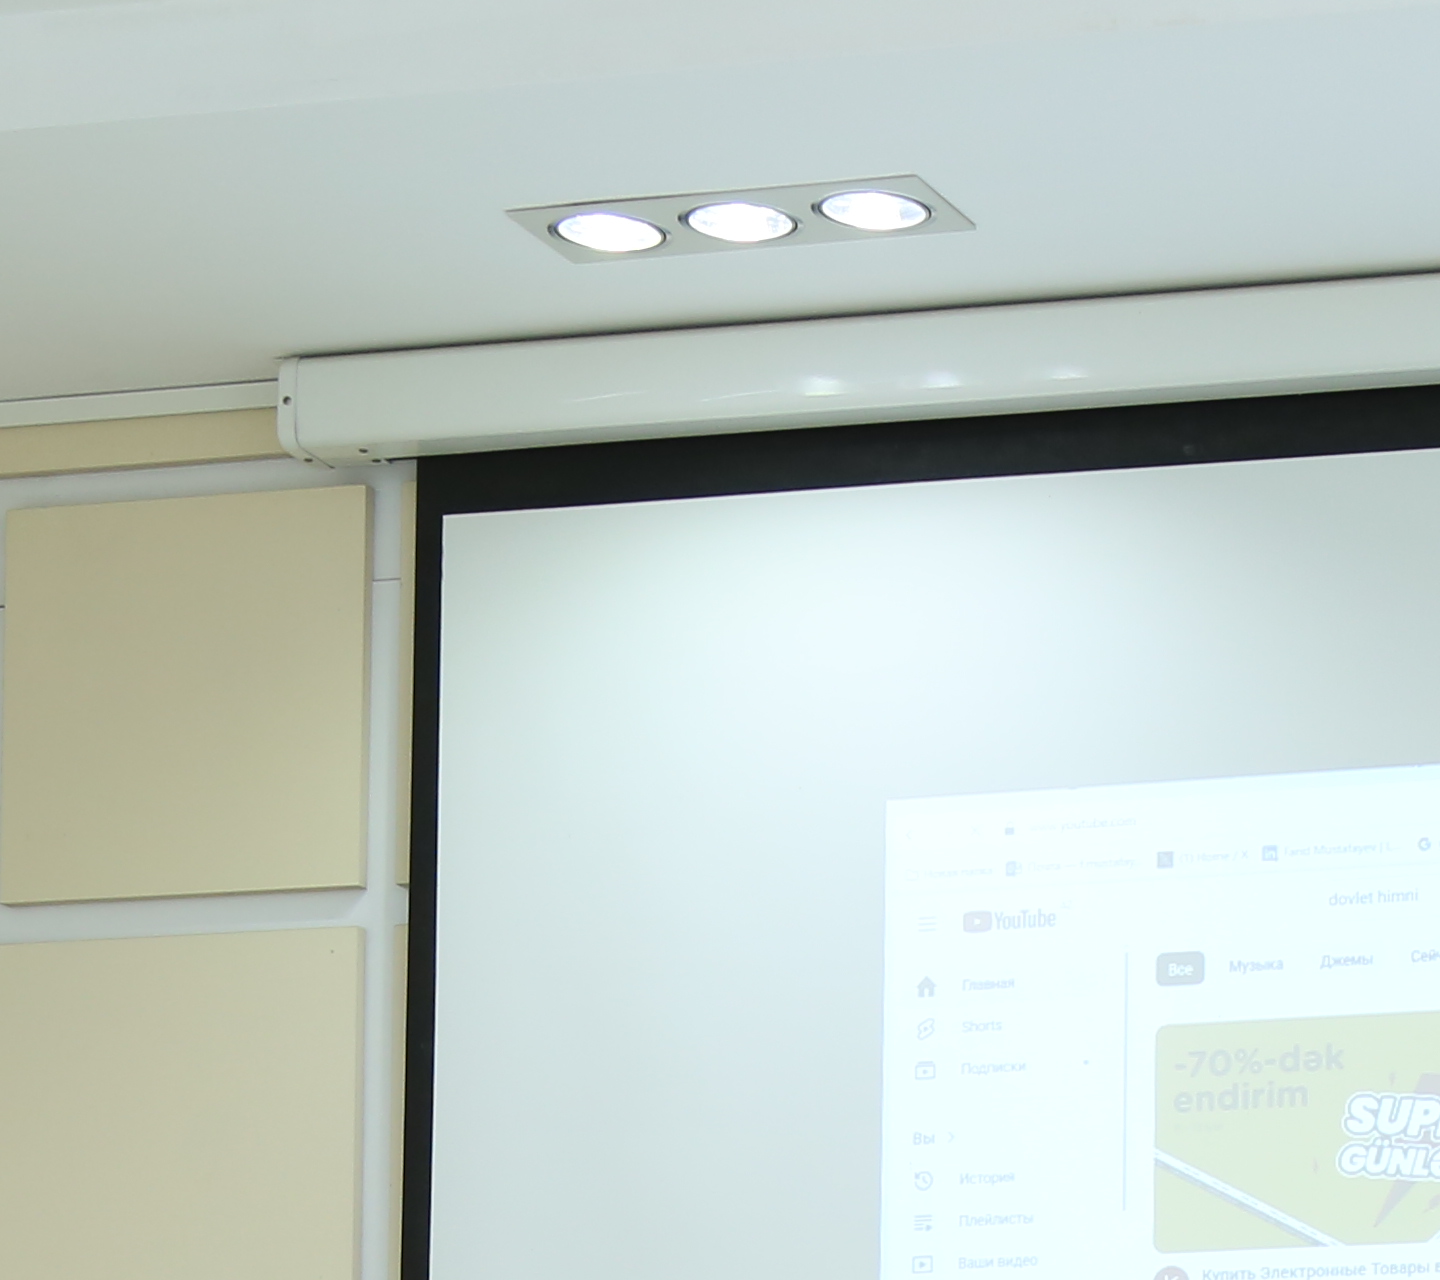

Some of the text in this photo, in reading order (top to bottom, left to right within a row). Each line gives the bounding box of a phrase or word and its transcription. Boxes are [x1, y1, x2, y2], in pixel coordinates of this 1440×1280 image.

[1329, 888, 1419, 907] dovlet himni
[994, 908, 1057, 930] YouTube
[1168, 962, 1194, 977] Все
[1229, 957, 1284, 975] Музыка
[1320, 953, 1374, 970] Джемы
[962, 977, 1015, 992] Главная
[961, 1019, 1003, 1033] Shorts
[961, 1061, 1027, 1077] Подписки
[1174, 1043, 1345, 1079] -70%-dək
[1174, 1081, 1309, 1114] endirim
[913, 1132, 935, 1146] Вы
[960, 1172, 1015, 1187] История
[959, 1212, 1034, 1228] Плейлисты
[958, 1254, 1039, 1270] Ваши видео
[1260, 1263, 1367, 1280] Электронные
[1372, 1261, 1430, 1279] Товары
